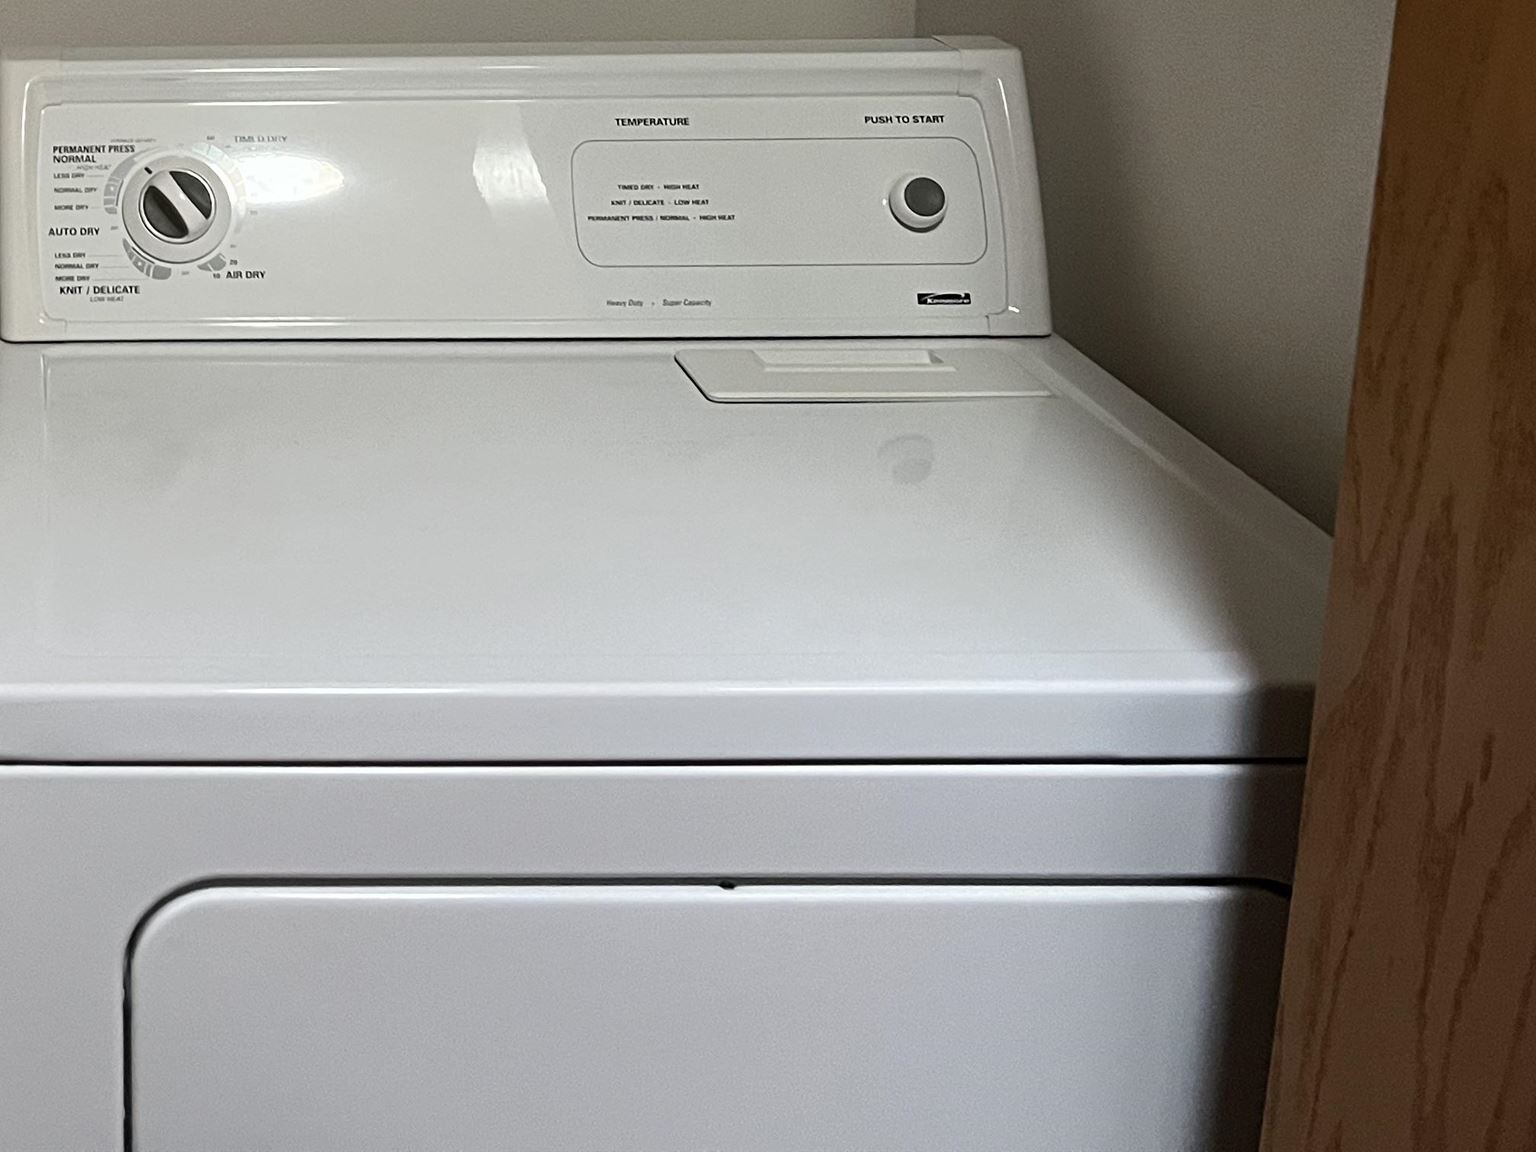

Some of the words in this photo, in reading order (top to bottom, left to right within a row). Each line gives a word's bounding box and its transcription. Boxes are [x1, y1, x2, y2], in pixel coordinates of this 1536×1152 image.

[614, 117, 690, 127] TEMPERATURE
[864, 115, 894, 124] PUSH
[895, 115, 910, 124] TO
[912, 114, 945, 124] START
[52, 145, 107, 154] PERMANENT
[108, 144, 136, 153] PRESS
[52, 154, 97, 164] NORMAL
[48, 227, 78, 237] AUTO
[79, 227, 101, 236] DRY
[225, 270, 243, 279] AIR
[245, 270, 266, 279] DRY
[59, 286, 83, 295] KNIT
[93, 285, 141, 295] DELICATE
[628, 298, 644, 307] Duty
[683, 298, 712, 307] Capacity
